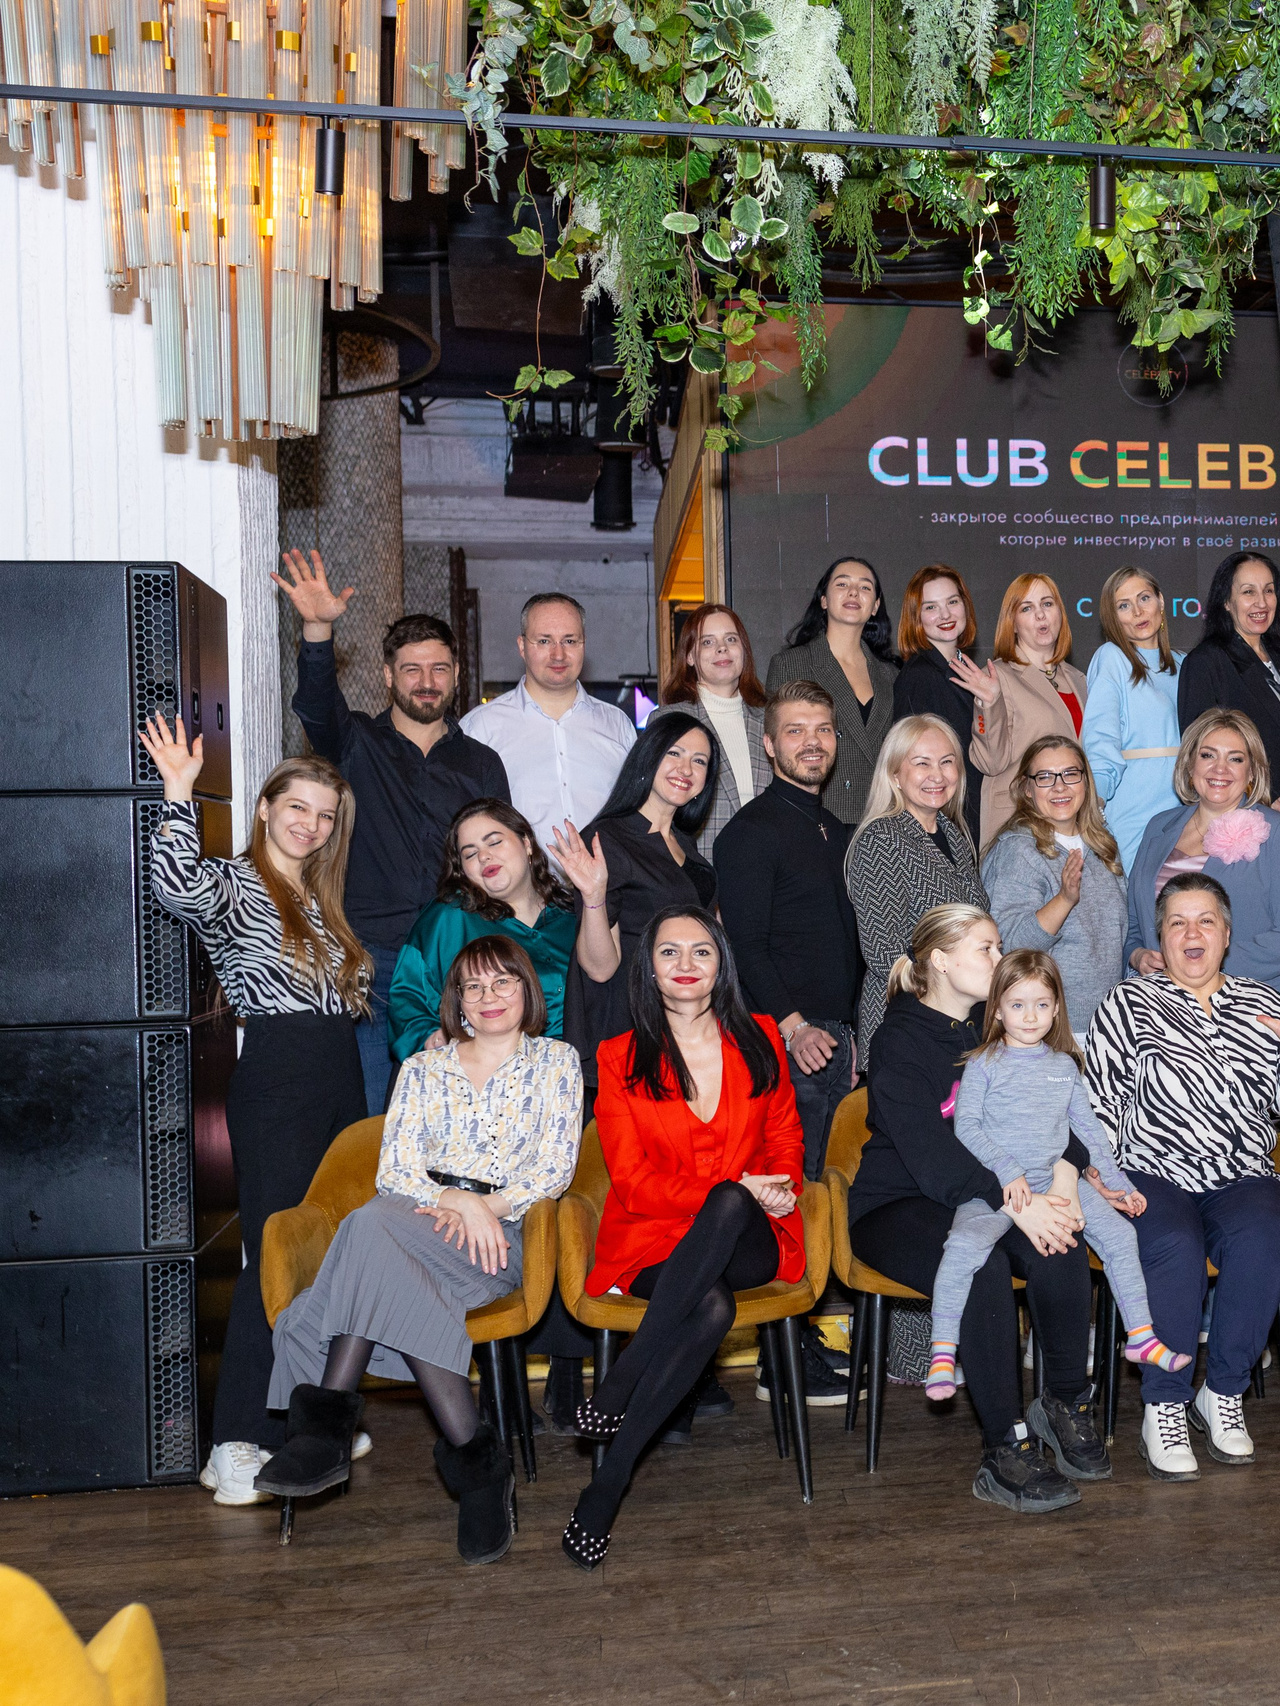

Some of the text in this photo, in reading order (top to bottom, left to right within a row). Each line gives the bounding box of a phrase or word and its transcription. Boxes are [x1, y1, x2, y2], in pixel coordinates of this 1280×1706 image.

[868, 436, 1049, 487] CLUB
[930, 511, 1007, 526] закрытое
[1014, 509, 1113, 524] сообщество
[1120, 512, 1278, 528] предпринимателей
[999, 535, 1067, 549] которые
[1073, 535, 1177, 549] инвестируют
[1182, 536, 1191, 547] в
[1196, 534, 1234, 548] своё
